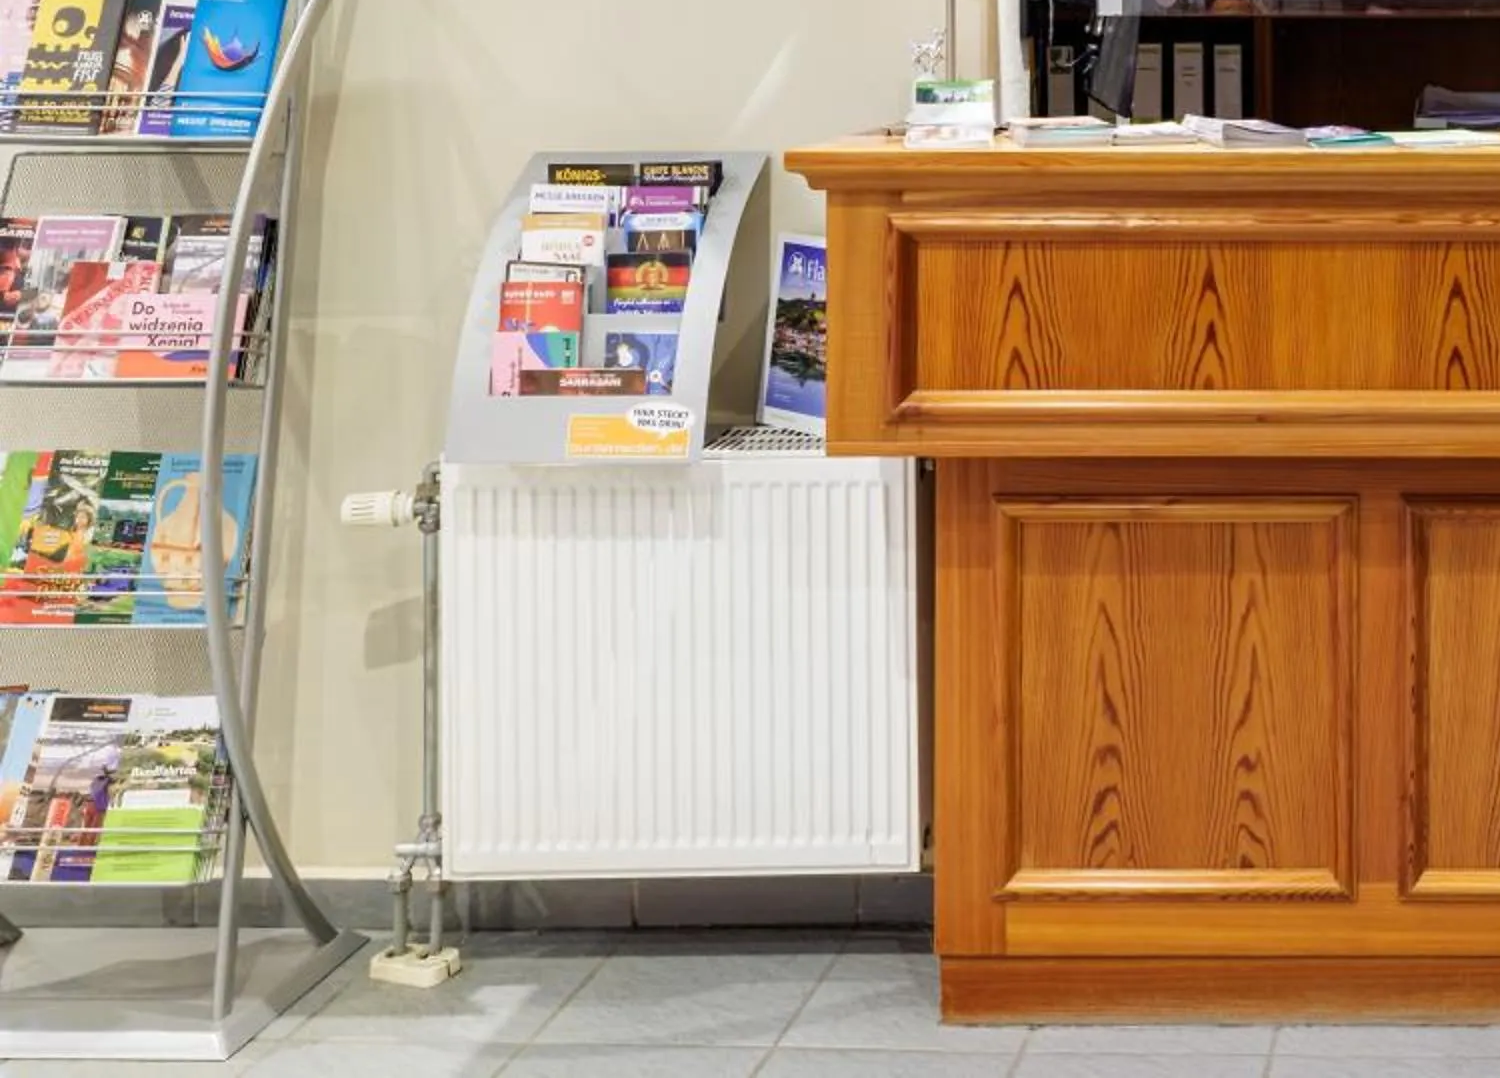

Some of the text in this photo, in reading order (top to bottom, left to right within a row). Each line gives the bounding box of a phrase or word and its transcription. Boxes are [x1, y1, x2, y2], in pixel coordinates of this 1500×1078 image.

[555, 168, 607, 181] KÖNIGS-
[132, 301, 155, 315] Do
[129, 317, 203, 331] widzenia
